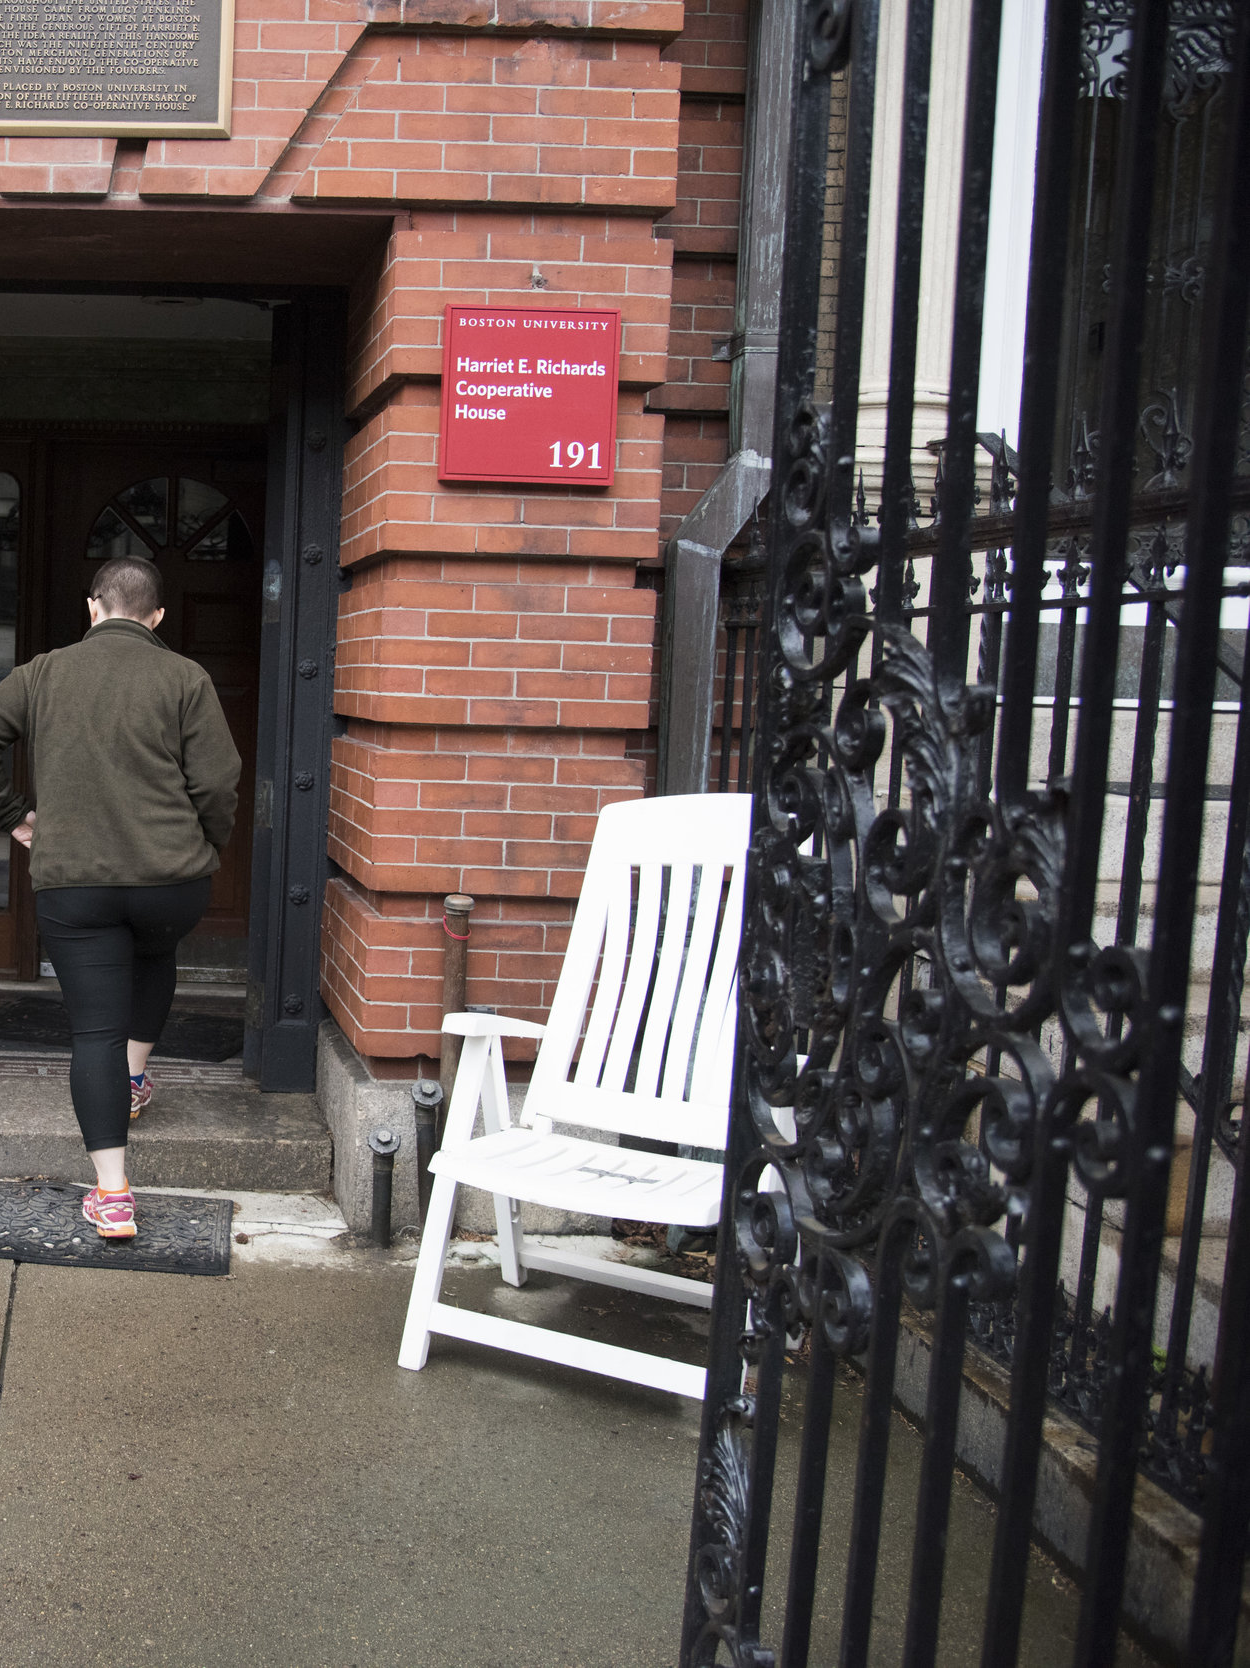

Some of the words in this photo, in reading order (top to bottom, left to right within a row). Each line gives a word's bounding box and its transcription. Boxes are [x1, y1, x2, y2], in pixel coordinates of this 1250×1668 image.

[68, 41, 195, 49] NINETEENTH-CENTURY
[460, 318, 516, 328] BOSTON
[524, 320, 609, 331] UNIVERSITY
[456, 357, 514, 374] Harriet
[518, 359, 532, 374] E.
[536, 359, 606, 376] Richards
[456, 380, 552, 399] Cooperative
[455, 404, 506, 420] House
[549, 440, 602, 469] 191
